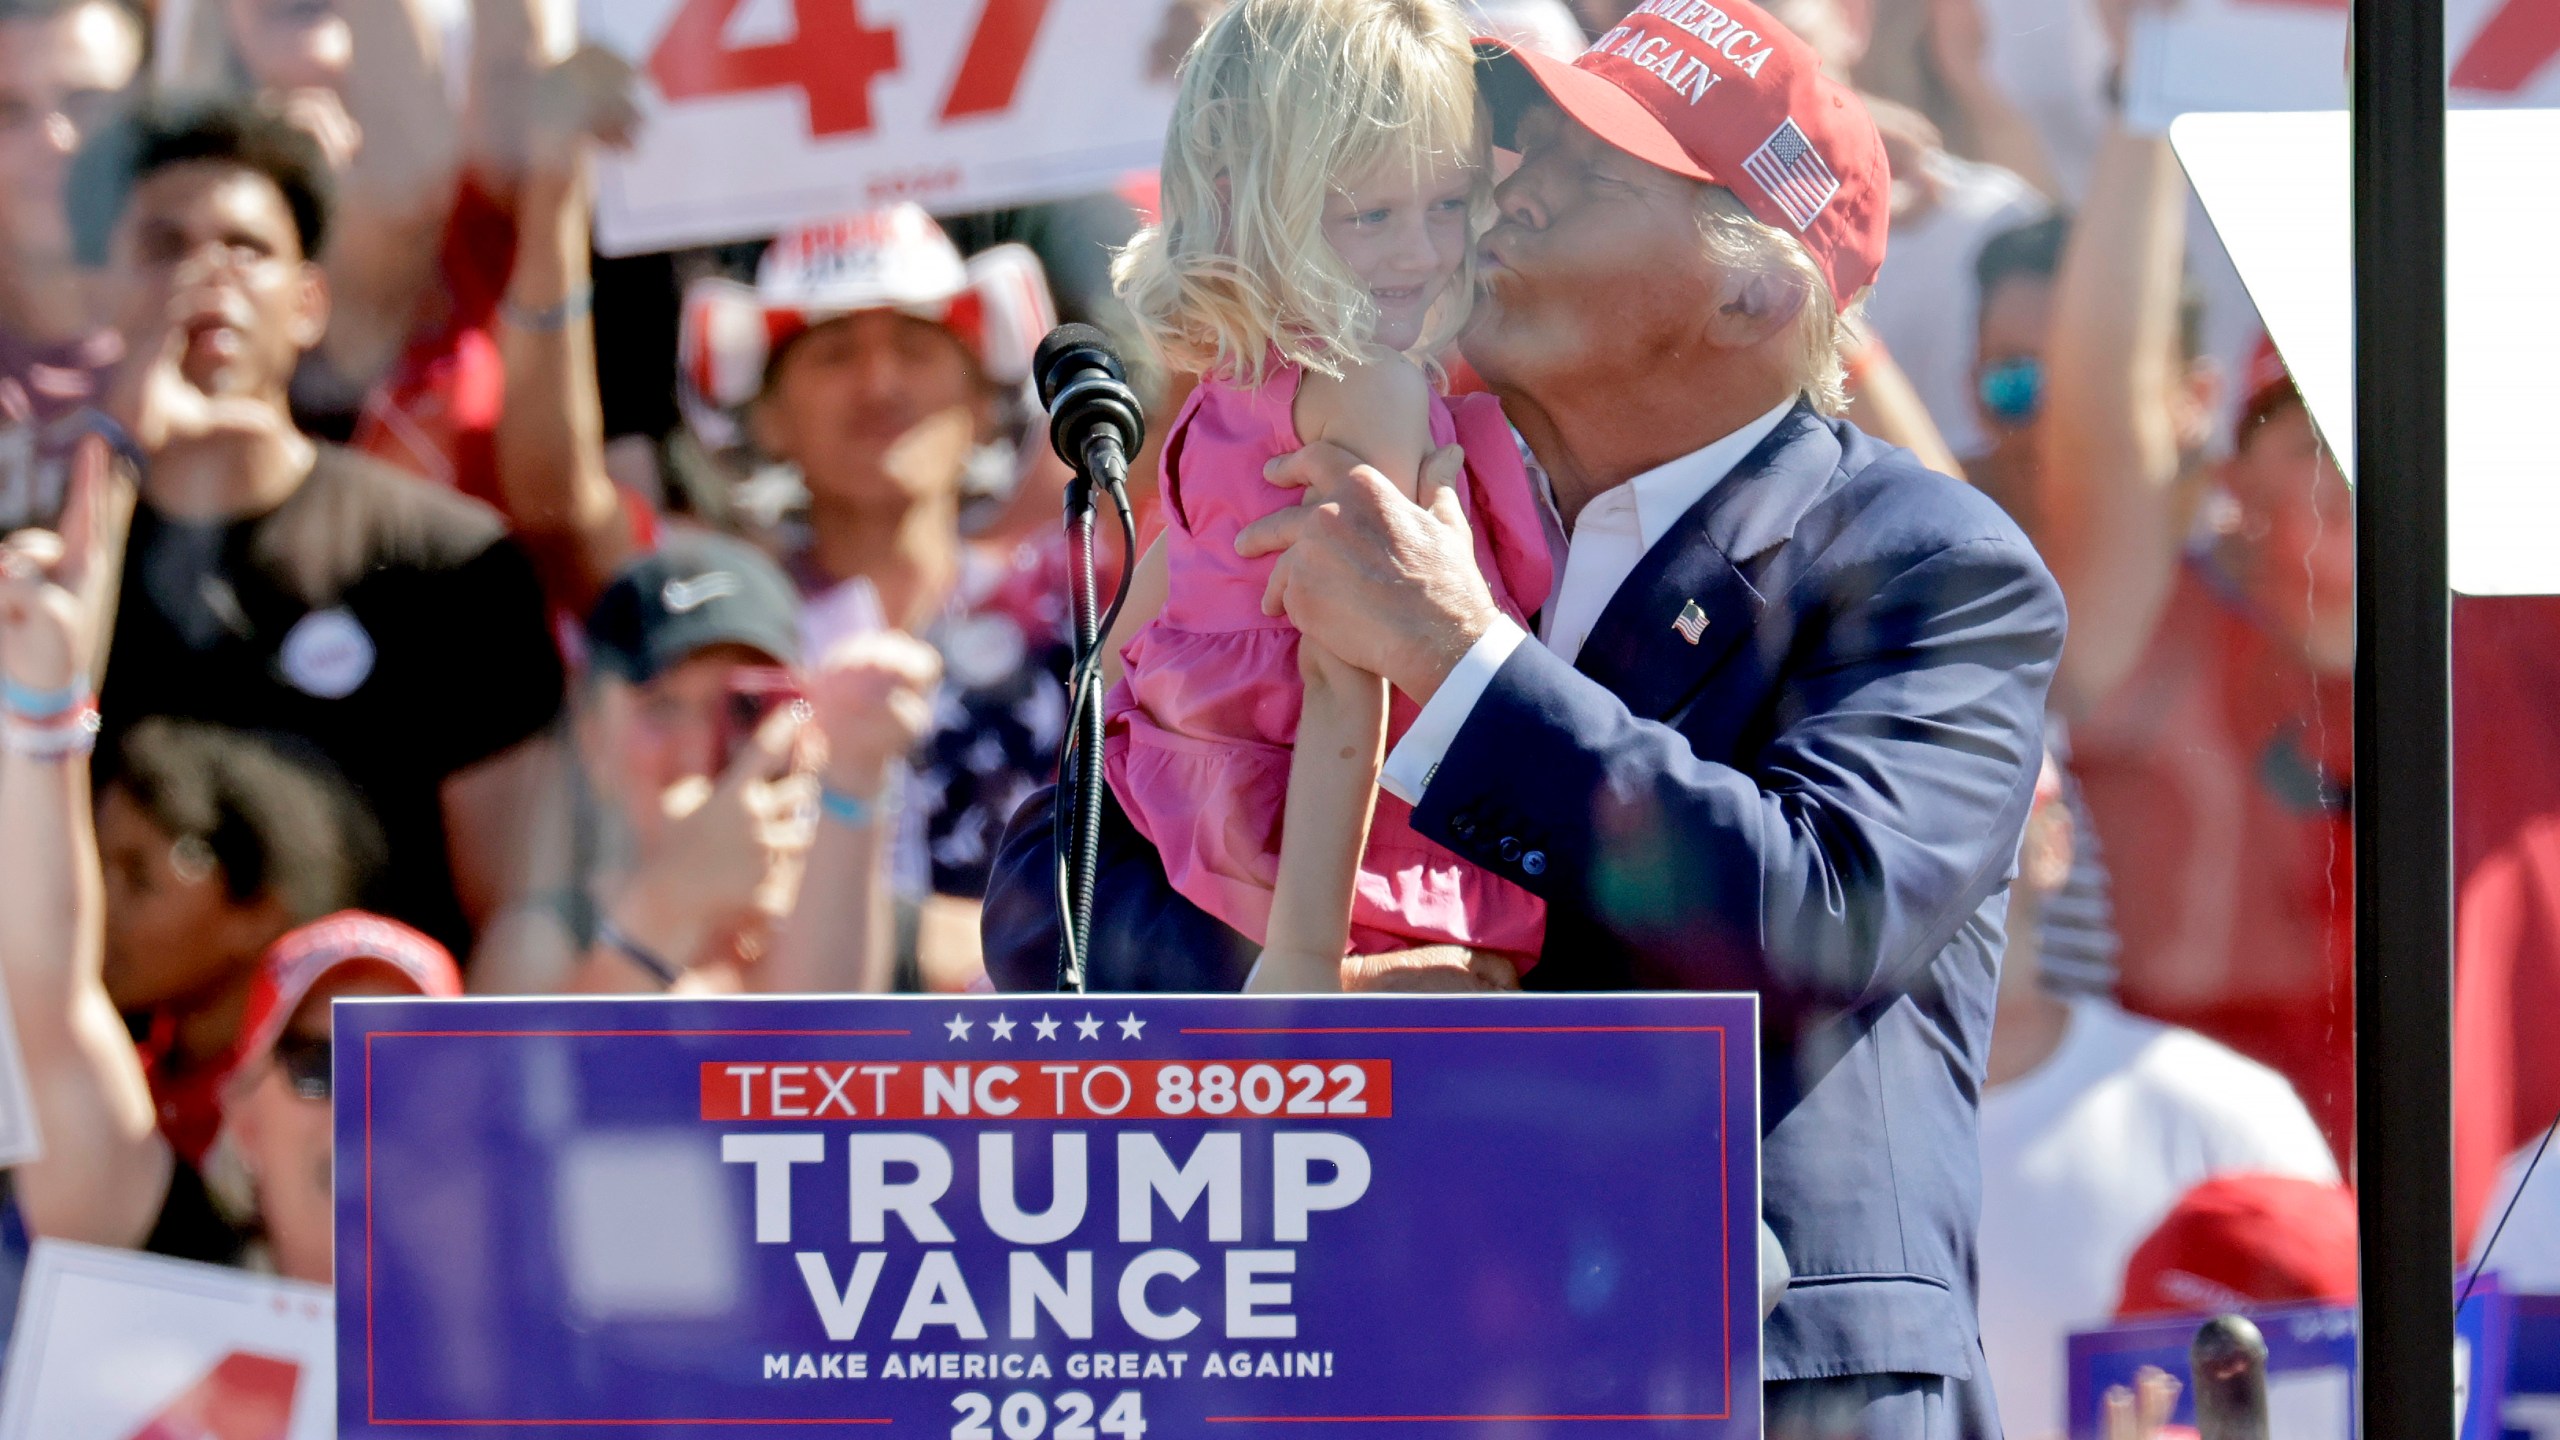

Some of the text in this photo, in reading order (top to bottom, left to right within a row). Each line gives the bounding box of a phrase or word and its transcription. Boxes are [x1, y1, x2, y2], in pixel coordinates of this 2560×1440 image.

[1610, 29, 1722, 106] AGAIN
[725, 1064, 1367, 1117] TEXT NC TO 88022
[721, 1131, 1372, 1245] TRUMP
[794, 1248, 1297, 1340] VANCE
[763, 1352, 1334, 1379] MAKE AMERICA GREAT AGAIN!
[950, 1390, 1147, 1440] 2024
